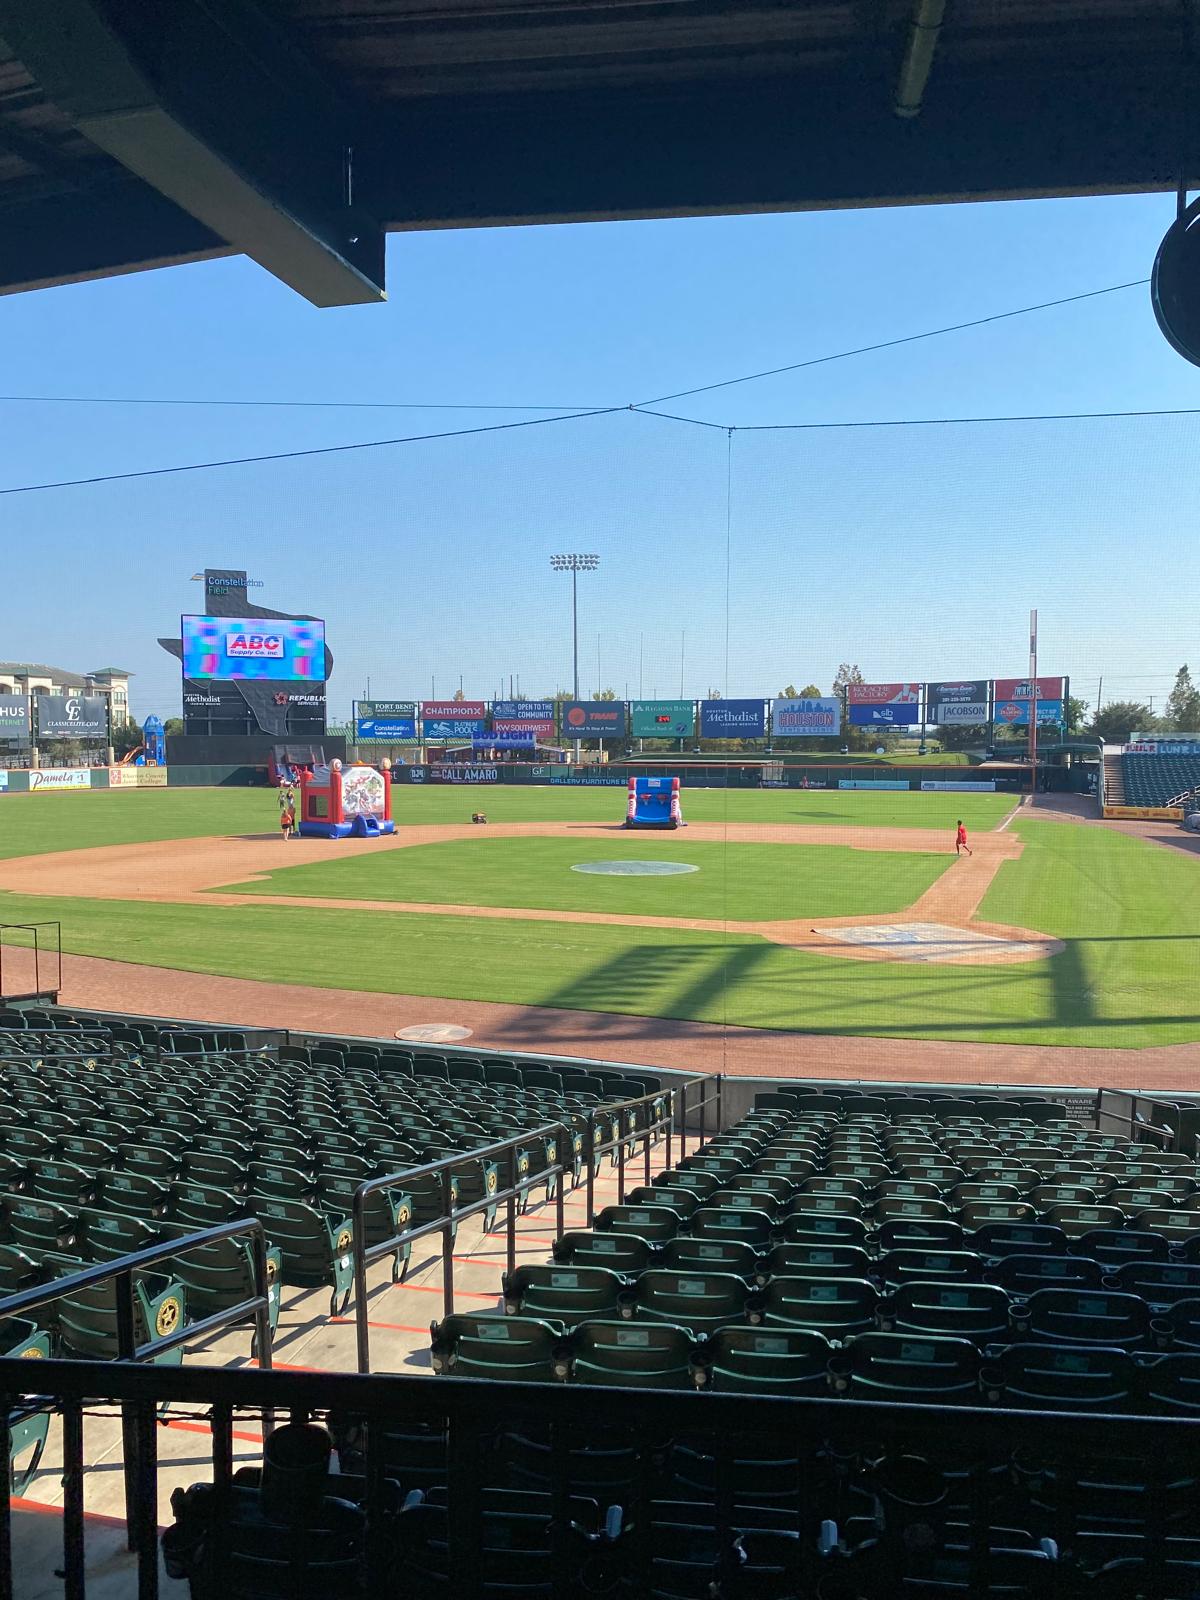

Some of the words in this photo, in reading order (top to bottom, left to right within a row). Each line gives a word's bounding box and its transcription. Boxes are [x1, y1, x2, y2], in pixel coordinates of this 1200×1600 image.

[208, 577, 264, 588] Constellation
[208, 587, 229, 595] Field
[230, 634, 280, 650] ABC
[517, 703, 533, 711] OPEN
[534, 703, 541, 711] TO
[542, 703, 553, 711] THE
[517, 711, 553, 719] COMMUNITY
[706, 711, 759, 722] Methodist
[880, 708, 894, 717] slb
[944, 706, 985, 720] JACOBSON
[779, 711, 835, 727] HOUSTON
[454, 726, 478, 734] POOLS
[511, 724, 550, 732] SOUTHWEST
[473, 731, 498, 739] BUD
[499, 731, 533, 739] LIGHT
[442, 768, 463, 780] CALL
[464, 768, 498, 780] AMARO
[532, 767, 545, 775] GF
[31, 771, 73, 791] Pamela
